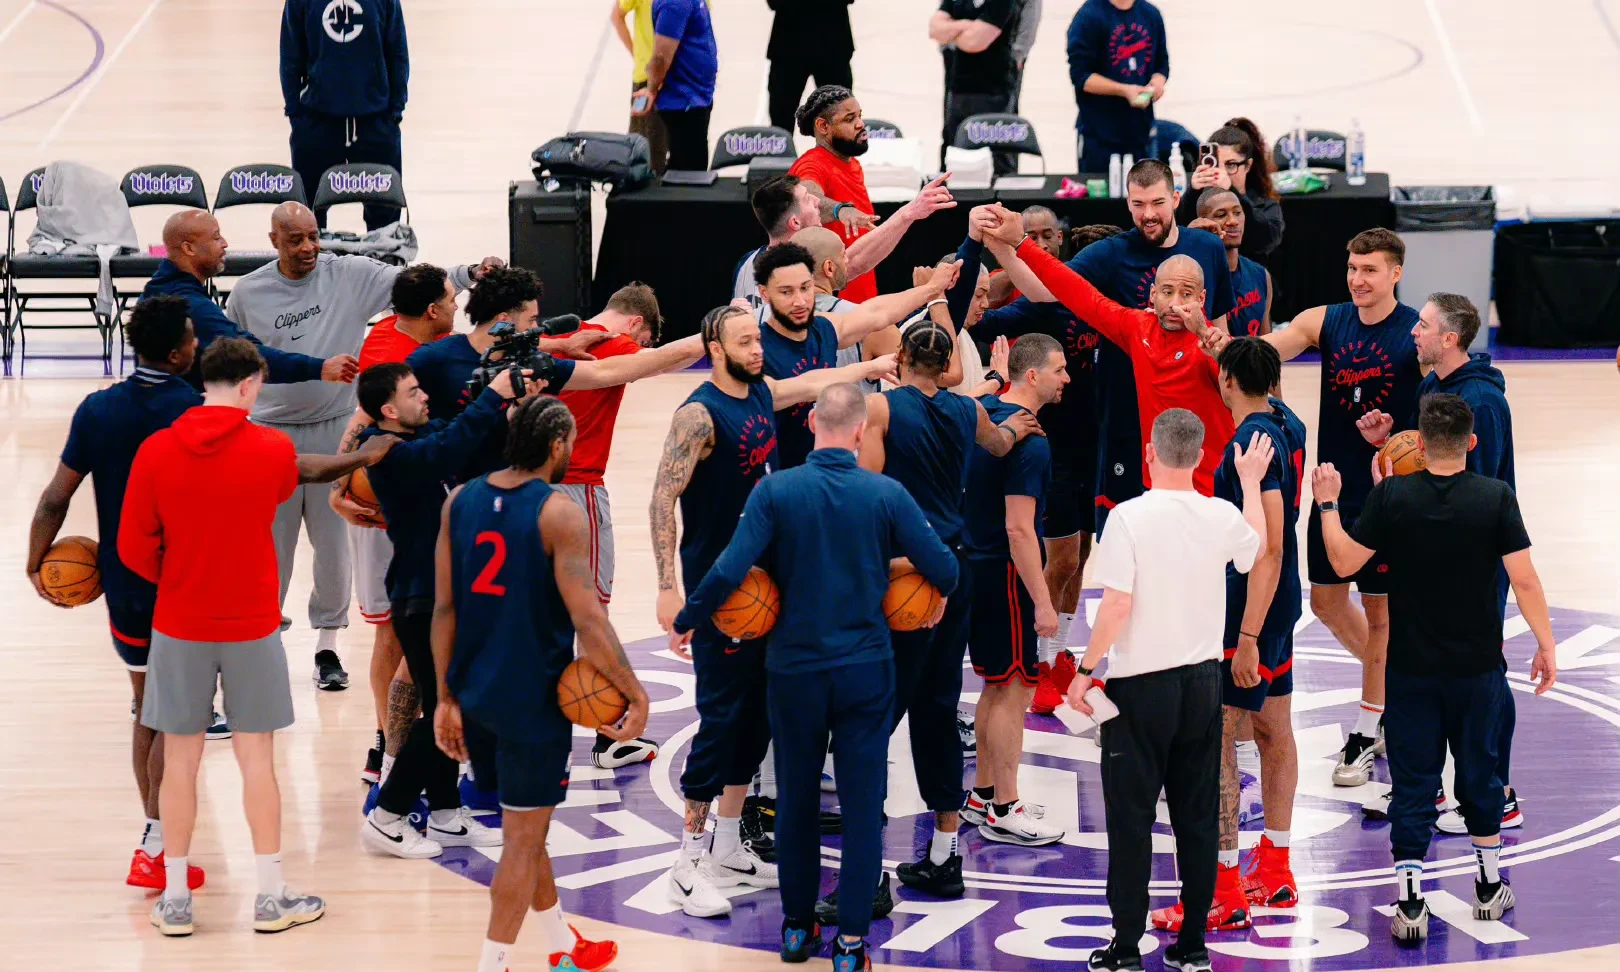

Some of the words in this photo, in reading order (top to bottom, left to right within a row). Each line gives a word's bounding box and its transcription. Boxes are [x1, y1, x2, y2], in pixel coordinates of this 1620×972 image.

[724, 132, 788, 155] Violets
[964, 120, 1029, 144] Violets
[130, 171, 193, 195] Violets
[229, 171, 293, 195] Violets
[328, 171, 392, 195] Violets
[275, 304, 321, 329] Clippers
[1335, 365, 1381, 387] Clippers
[471, 530, 506, 596] 2
